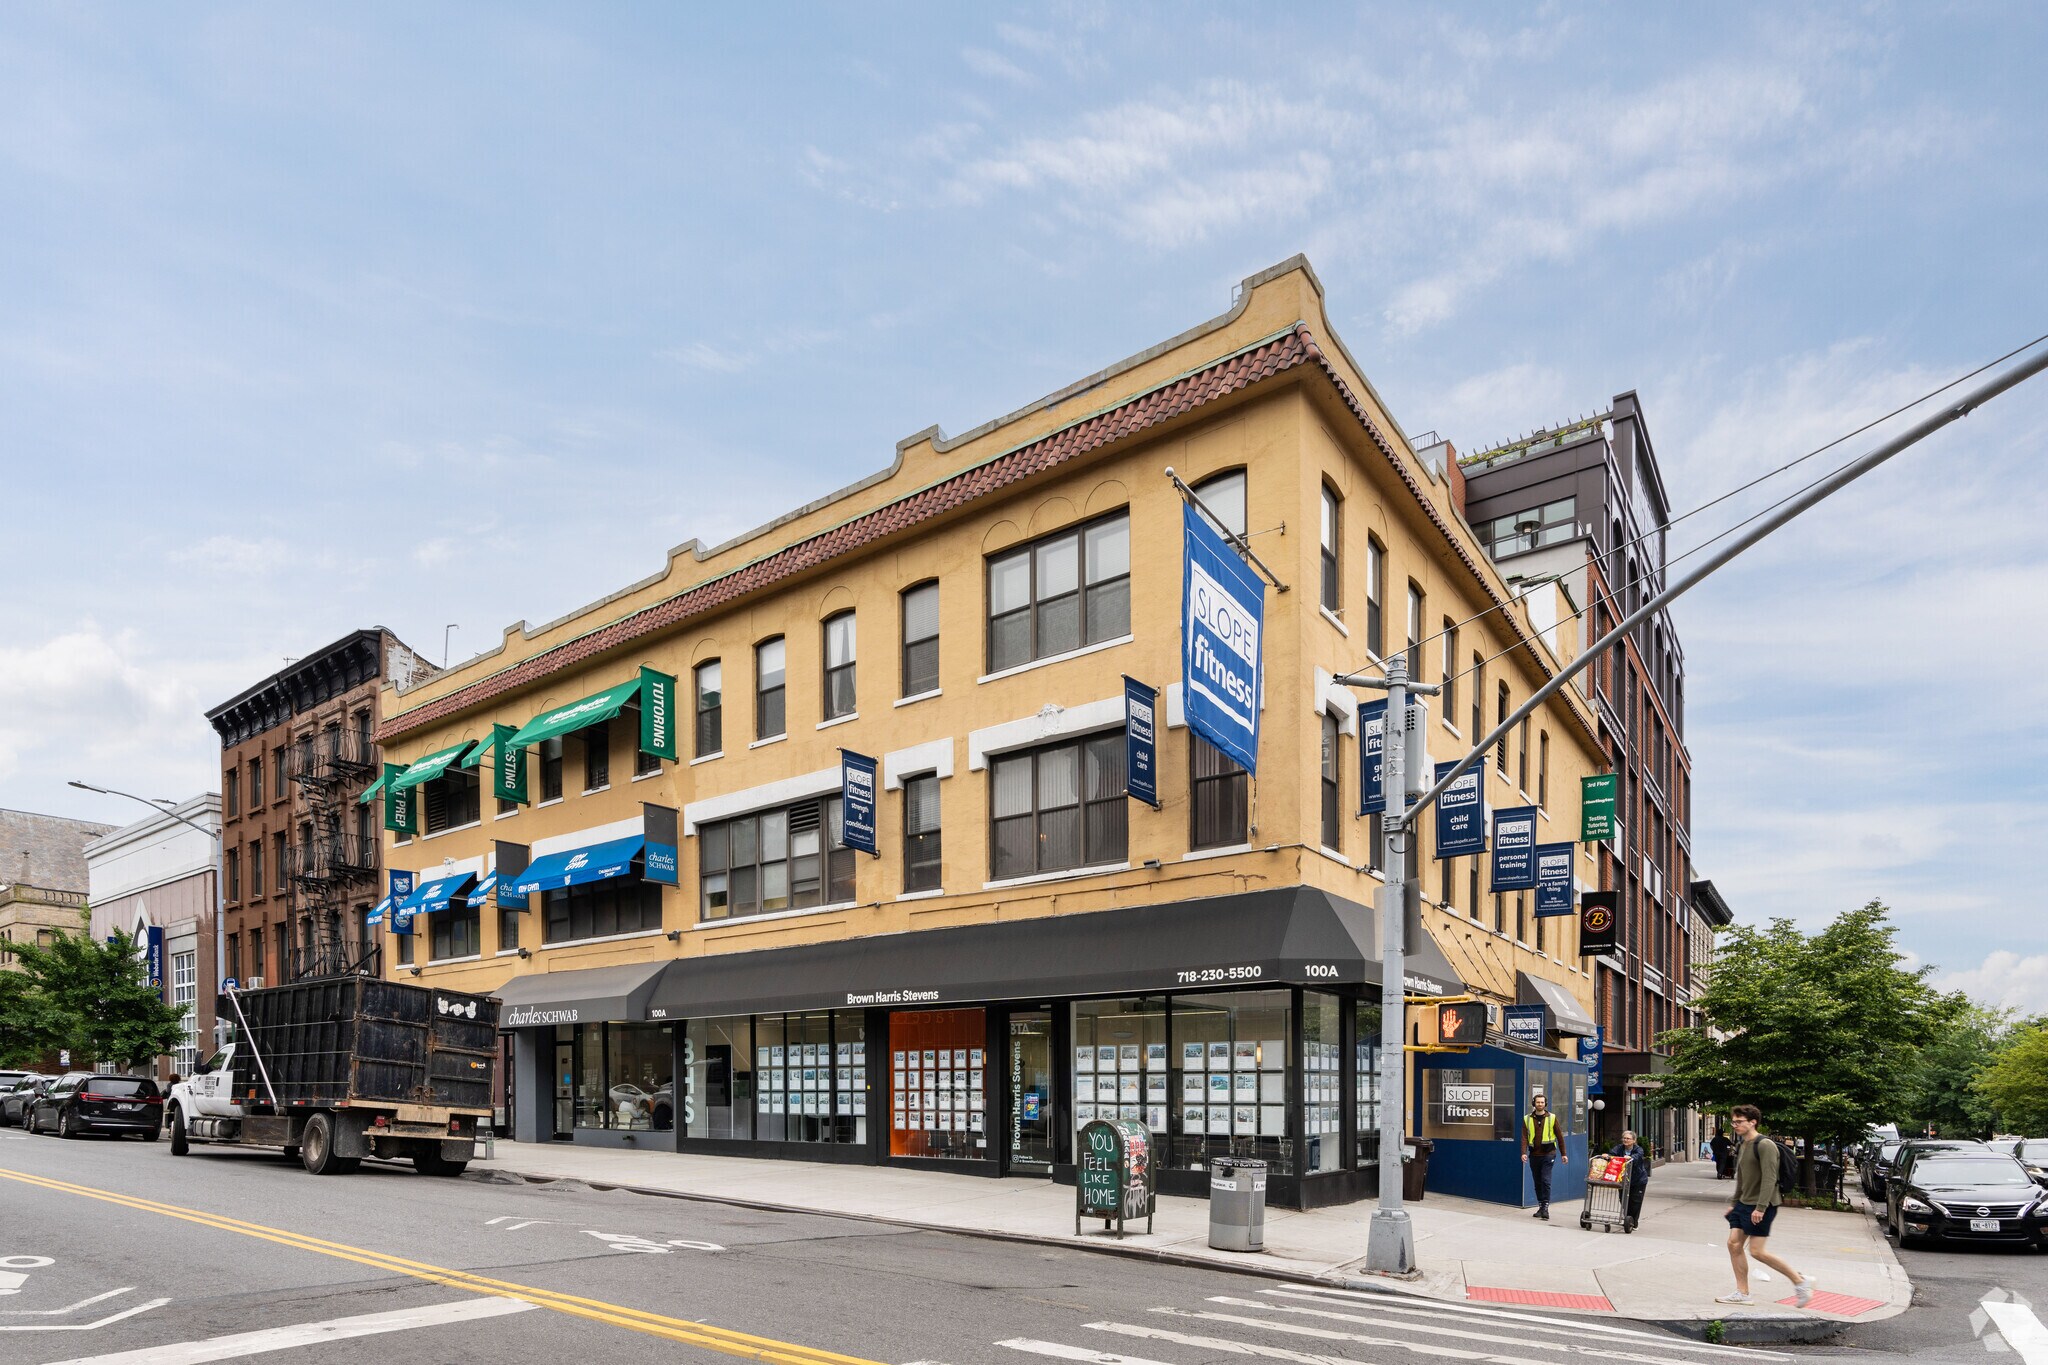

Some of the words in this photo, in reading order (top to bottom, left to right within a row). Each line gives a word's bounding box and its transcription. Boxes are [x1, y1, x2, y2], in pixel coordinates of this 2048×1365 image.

[1197, 587, 1252, 661] SLOPE
[1194, 633, 1253, 709] fitness
[652, 682, 665, 748] TUTORING
[1131, 704, 1151, 723] SLOPE
[1131, 718, 1152, 738] fitness
[1136, 750, 1149, 762] child
[505, 750, 516, 790] ESTING
[1136, 761, 1148, 771] care
[849, 772, 871, 786] SLOPE
[849, 783, 871, 799] fitness
[1443, 791, 1476, 804] fitness
[395, 799, 406, 827] PREP
[851, 802, 870, 814] strength
[858, 812, 863, 820] &
[1450, 814, 1469, 824] child
[845, 819, 874, 834] conditioning
[1451, 823, 1469, 831] care
[1500, 824, 1528, 834] SLOPE
[1500, 835, 1529, 845] fitness
[648, 851, 674, 865] charles
[1499, 853, 1528, 862] personal
[1542, 859, 1567, 867] SLOPE
[648, 860, 675, 872] SCHWAB
[1541, 868, 1567, 876] fitness
[1176, 965, 1262, 983] 718-230-5500
[1304, 964, 1339, 978] 100A
[847, 993, 874, 1004] Brown
[875, 990, 901, 1003] Harris
[902, 989, 939, 1001] Stevens
[508, 1005, 542, 1025] charles
[541, 1009, 579, 1023] SCHWAB
[651, 1009, 667, 1018] 100A
[1510, 1021, 1538, 1031] SLOPE
[1510, 1030, 1539, 1039] fitness
[1012, 1041, 1021, 1083] Stevens
[1012, 1084, 1021, 1112] Harris
[1448, 1089, 1489, 1101] SLOPE
[1446, 1104, 1490, 1118] fitness
[1012, 1113, 1021, 1150] Brown
[1088, 1131, 1115, 1152] YOU
[1083, 1152, 1112, 1171] FEEL
[1084, 1172, 1110, 1185] LIKE
[1084, 1187, 1117, 1206] HOME
